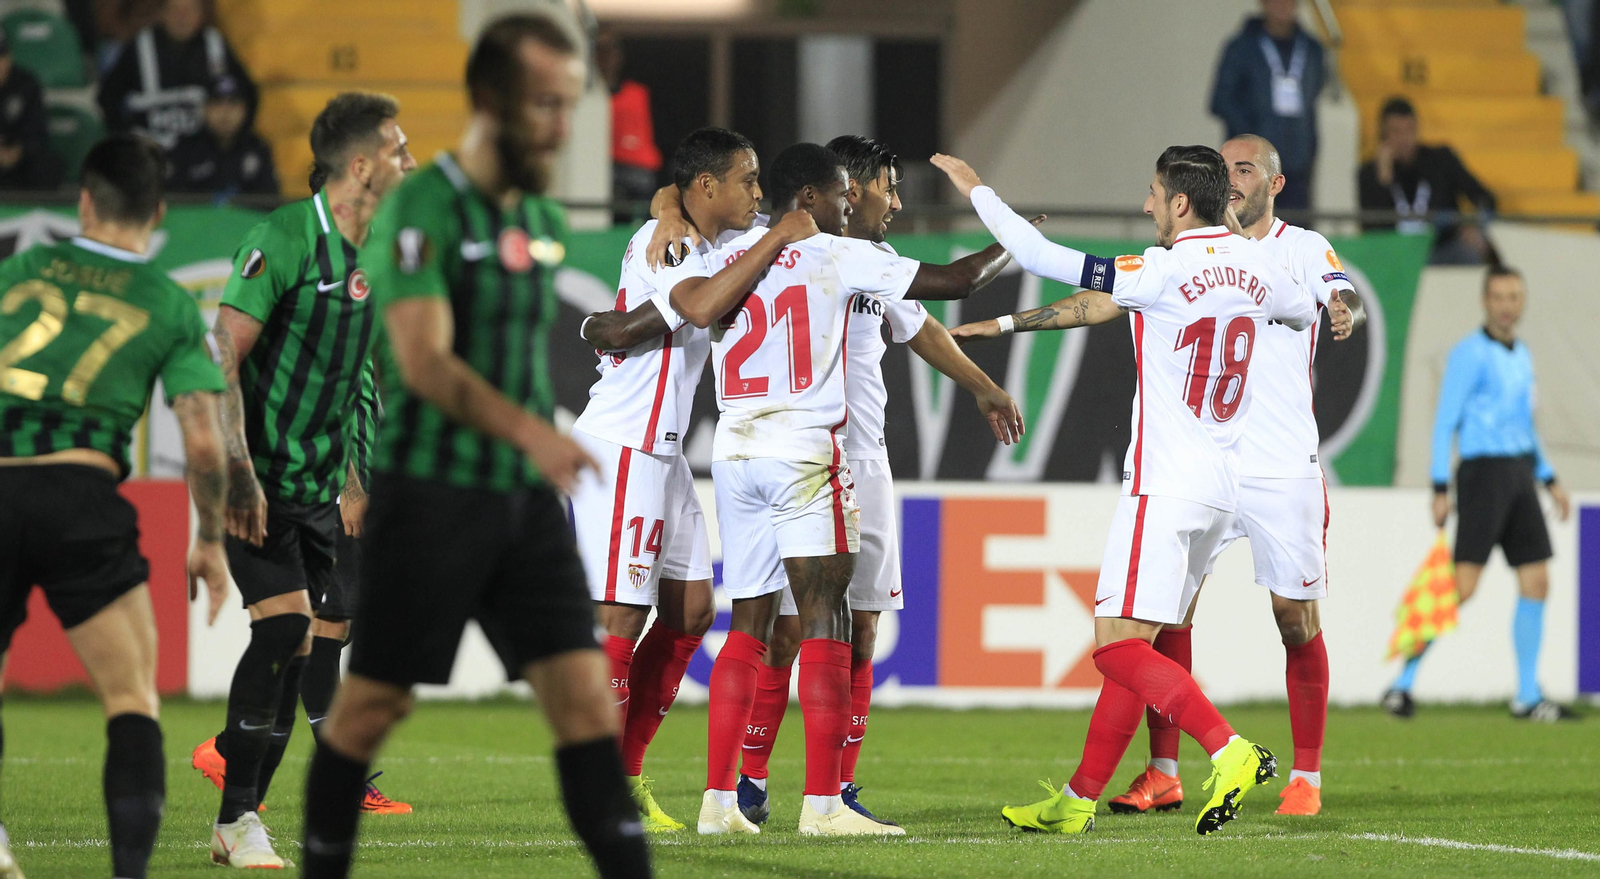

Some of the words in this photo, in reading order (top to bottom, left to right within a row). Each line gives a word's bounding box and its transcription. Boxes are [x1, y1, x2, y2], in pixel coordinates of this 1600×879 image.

[1178, 266, 1267, 306] ESCUDERO
[0, 279, 149, 407] 27
[718, 284, 813, 401] 21
[1174, 316, 1256, 423] 18
[627, 515, 665, 562] 14
[746, 724, 768, 737] SFC
